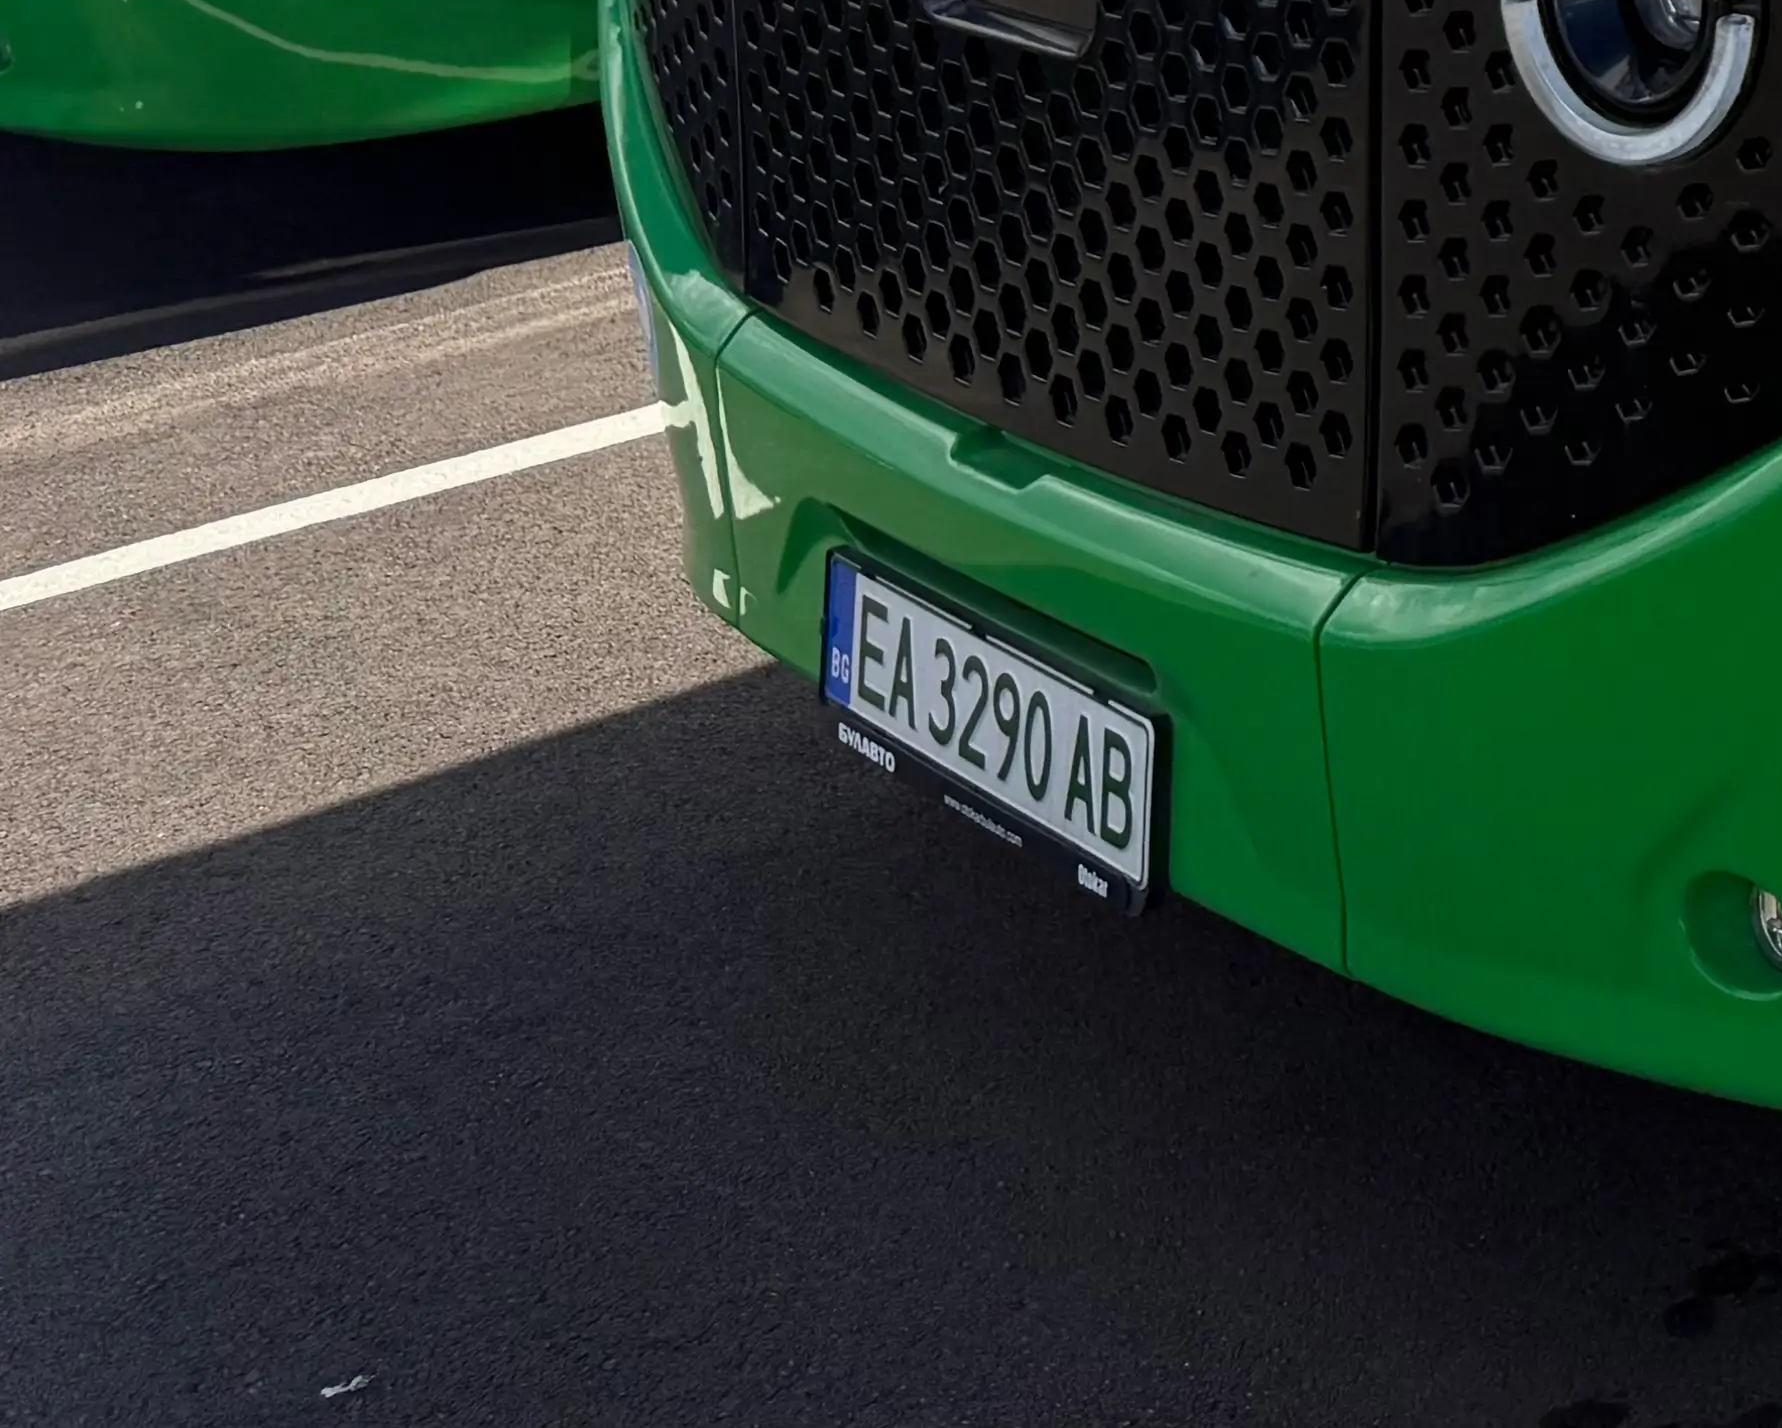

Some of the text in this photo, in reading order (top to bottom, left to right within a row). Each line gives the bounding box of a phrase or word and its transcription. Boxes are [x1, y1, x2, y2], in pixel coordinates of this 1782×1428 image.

[831, 646, 850, 684] BG
[838, 720, 896, 774] БУЛАВТО
[857, 594, 918, 731] EA
[928, 637, 1052, 802] 3290
[1063, 714, 1133, 850] AB
